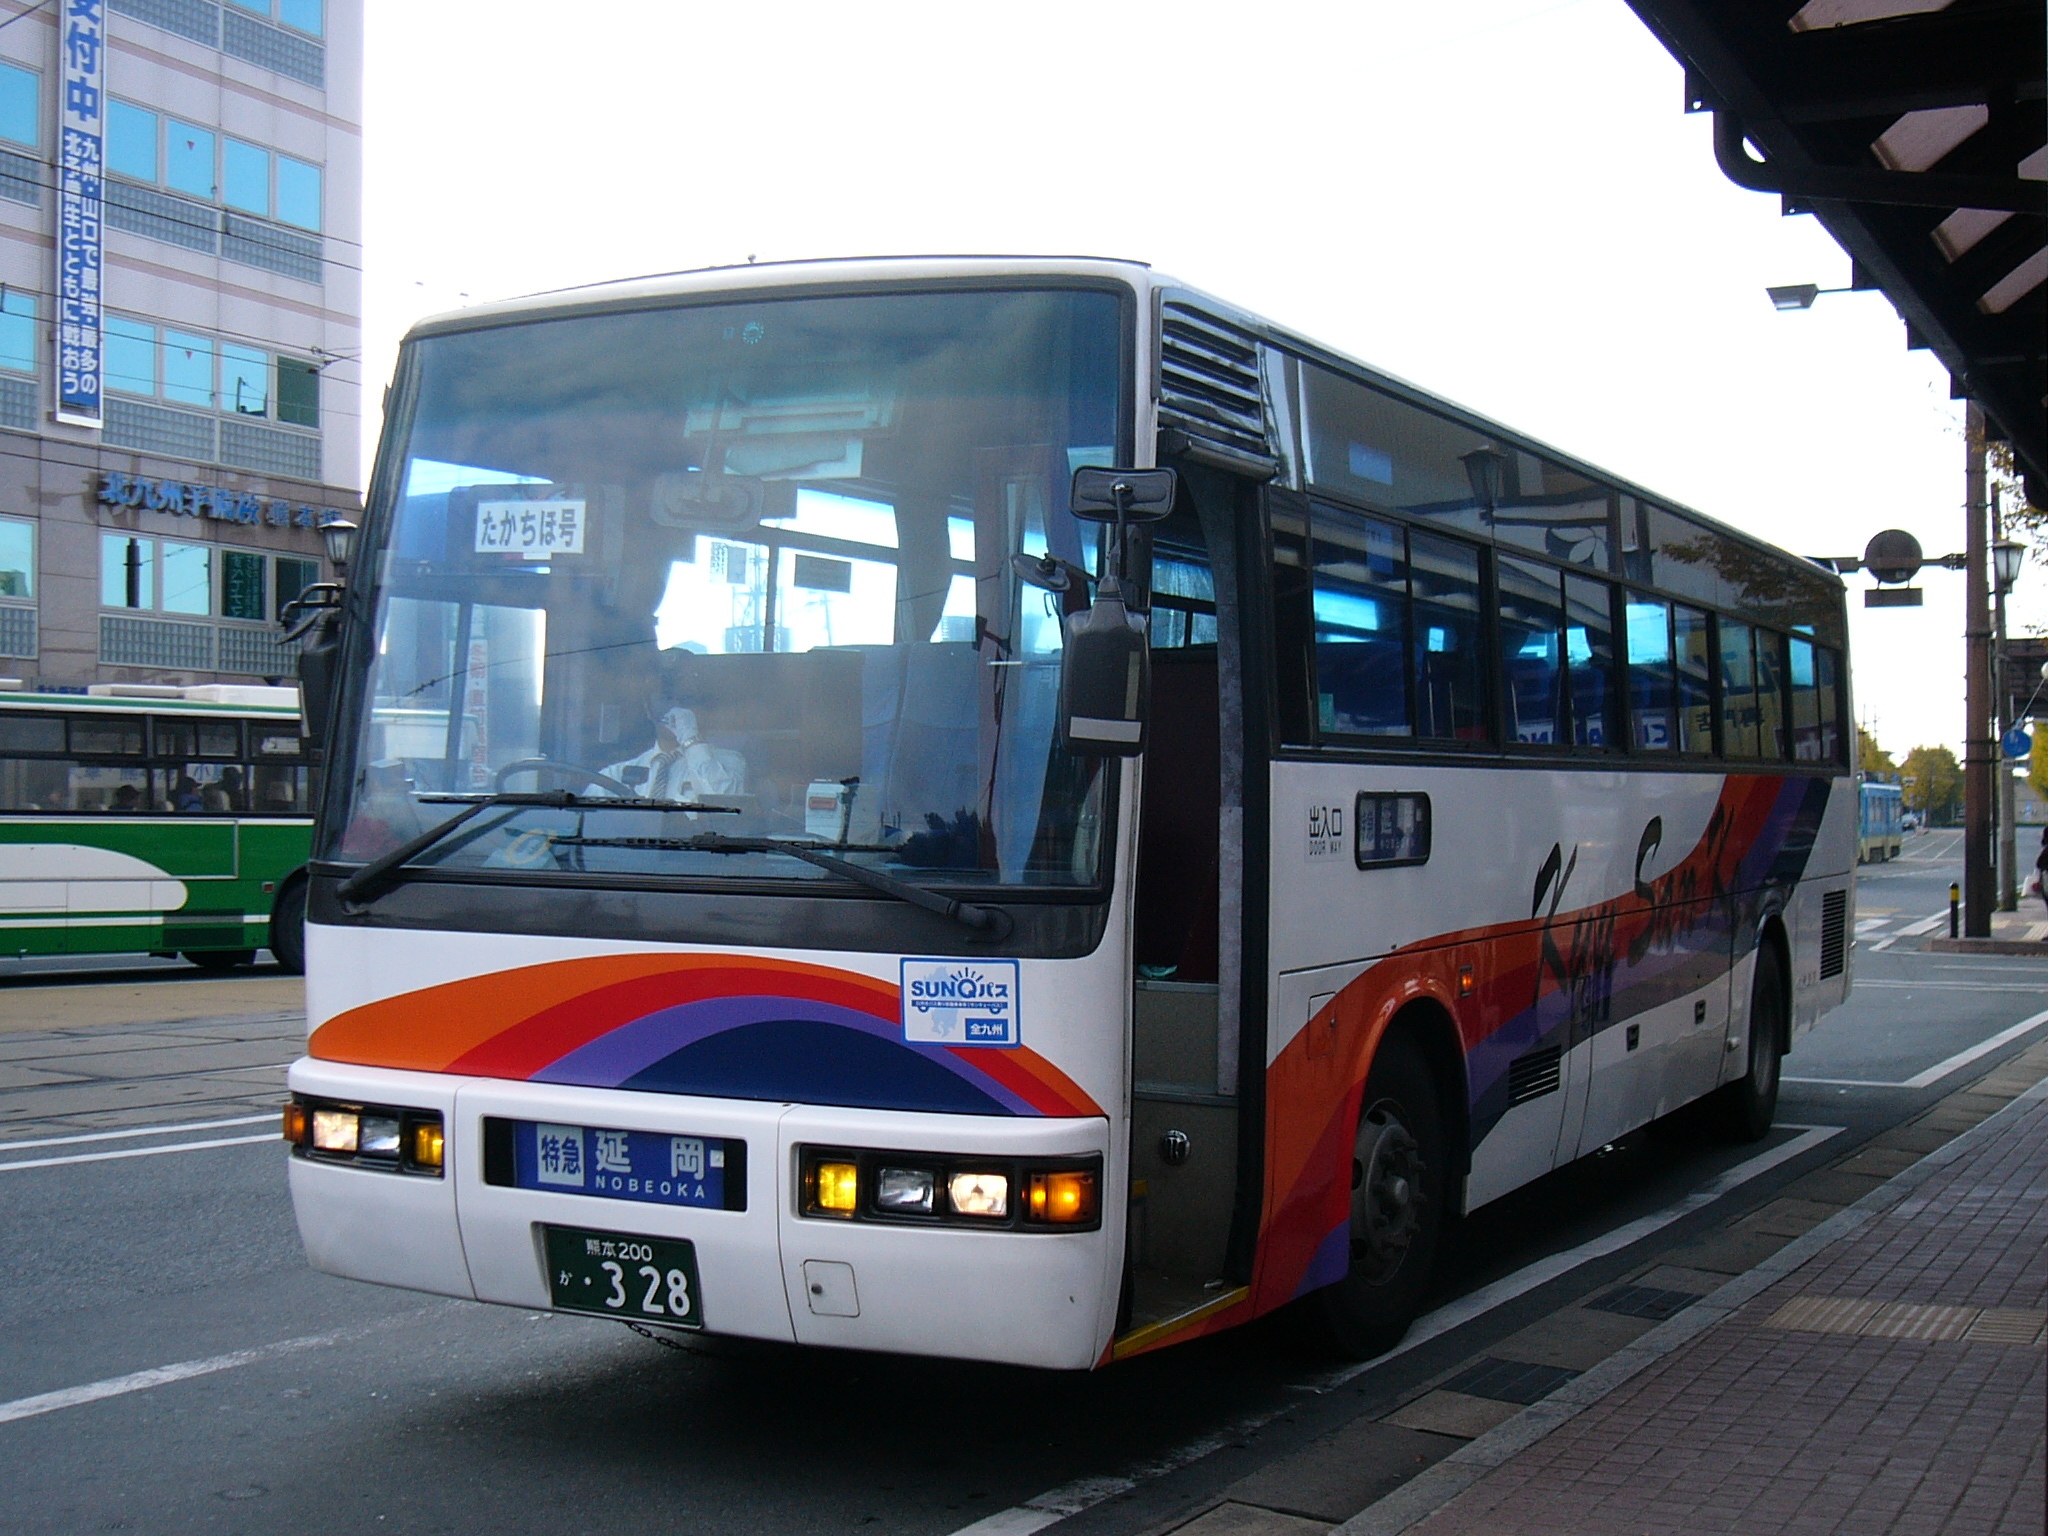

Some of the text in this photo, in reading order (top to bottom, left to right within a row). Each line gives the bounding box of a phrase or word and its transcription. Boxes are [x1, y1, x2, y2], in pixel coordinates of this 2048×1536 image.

[99, 472, 261, 526] 北九州予備校
[481, 508, 577, 547] たかちほ号
[1309, 805, 1342, 838] 出入口
[970, 1023, 1003, 1036] 全九州
[541, 1134, 581, 1176] 特急
[595, 1175, 705, 1199] NOBEOKA
